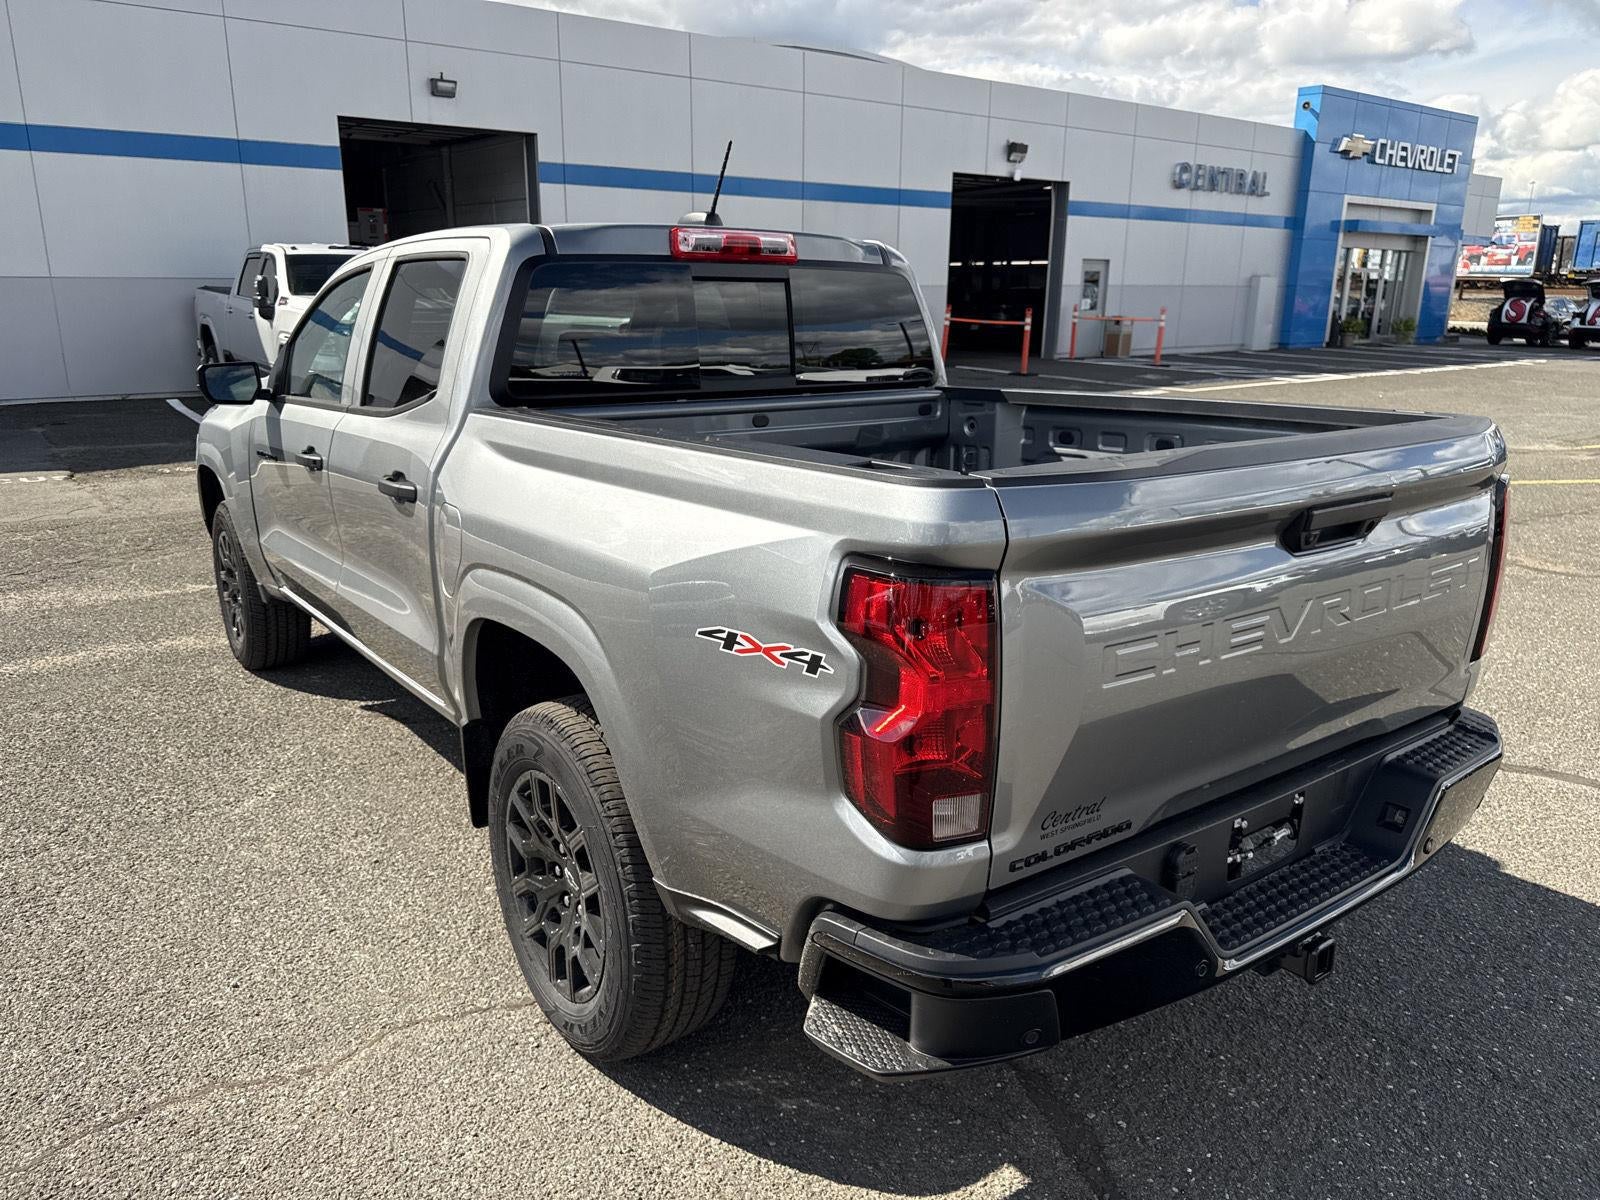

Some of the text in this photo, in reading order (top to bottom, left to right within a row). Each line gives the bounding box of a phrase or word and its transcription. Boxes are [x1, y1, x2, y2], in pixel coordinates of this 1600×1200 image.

[1374, 138, 1463, 174] CHEVROLET
[1171, 162, 1270, 197] CENTRAL
[1102, 552, 1480, 689] CHEVROLET
[1040, 796, 1106, 831] Central
[1040, 814, 1102, 841] WEST SPRINGFIELD
[1009, 819, 1133, 872] COLORADO
